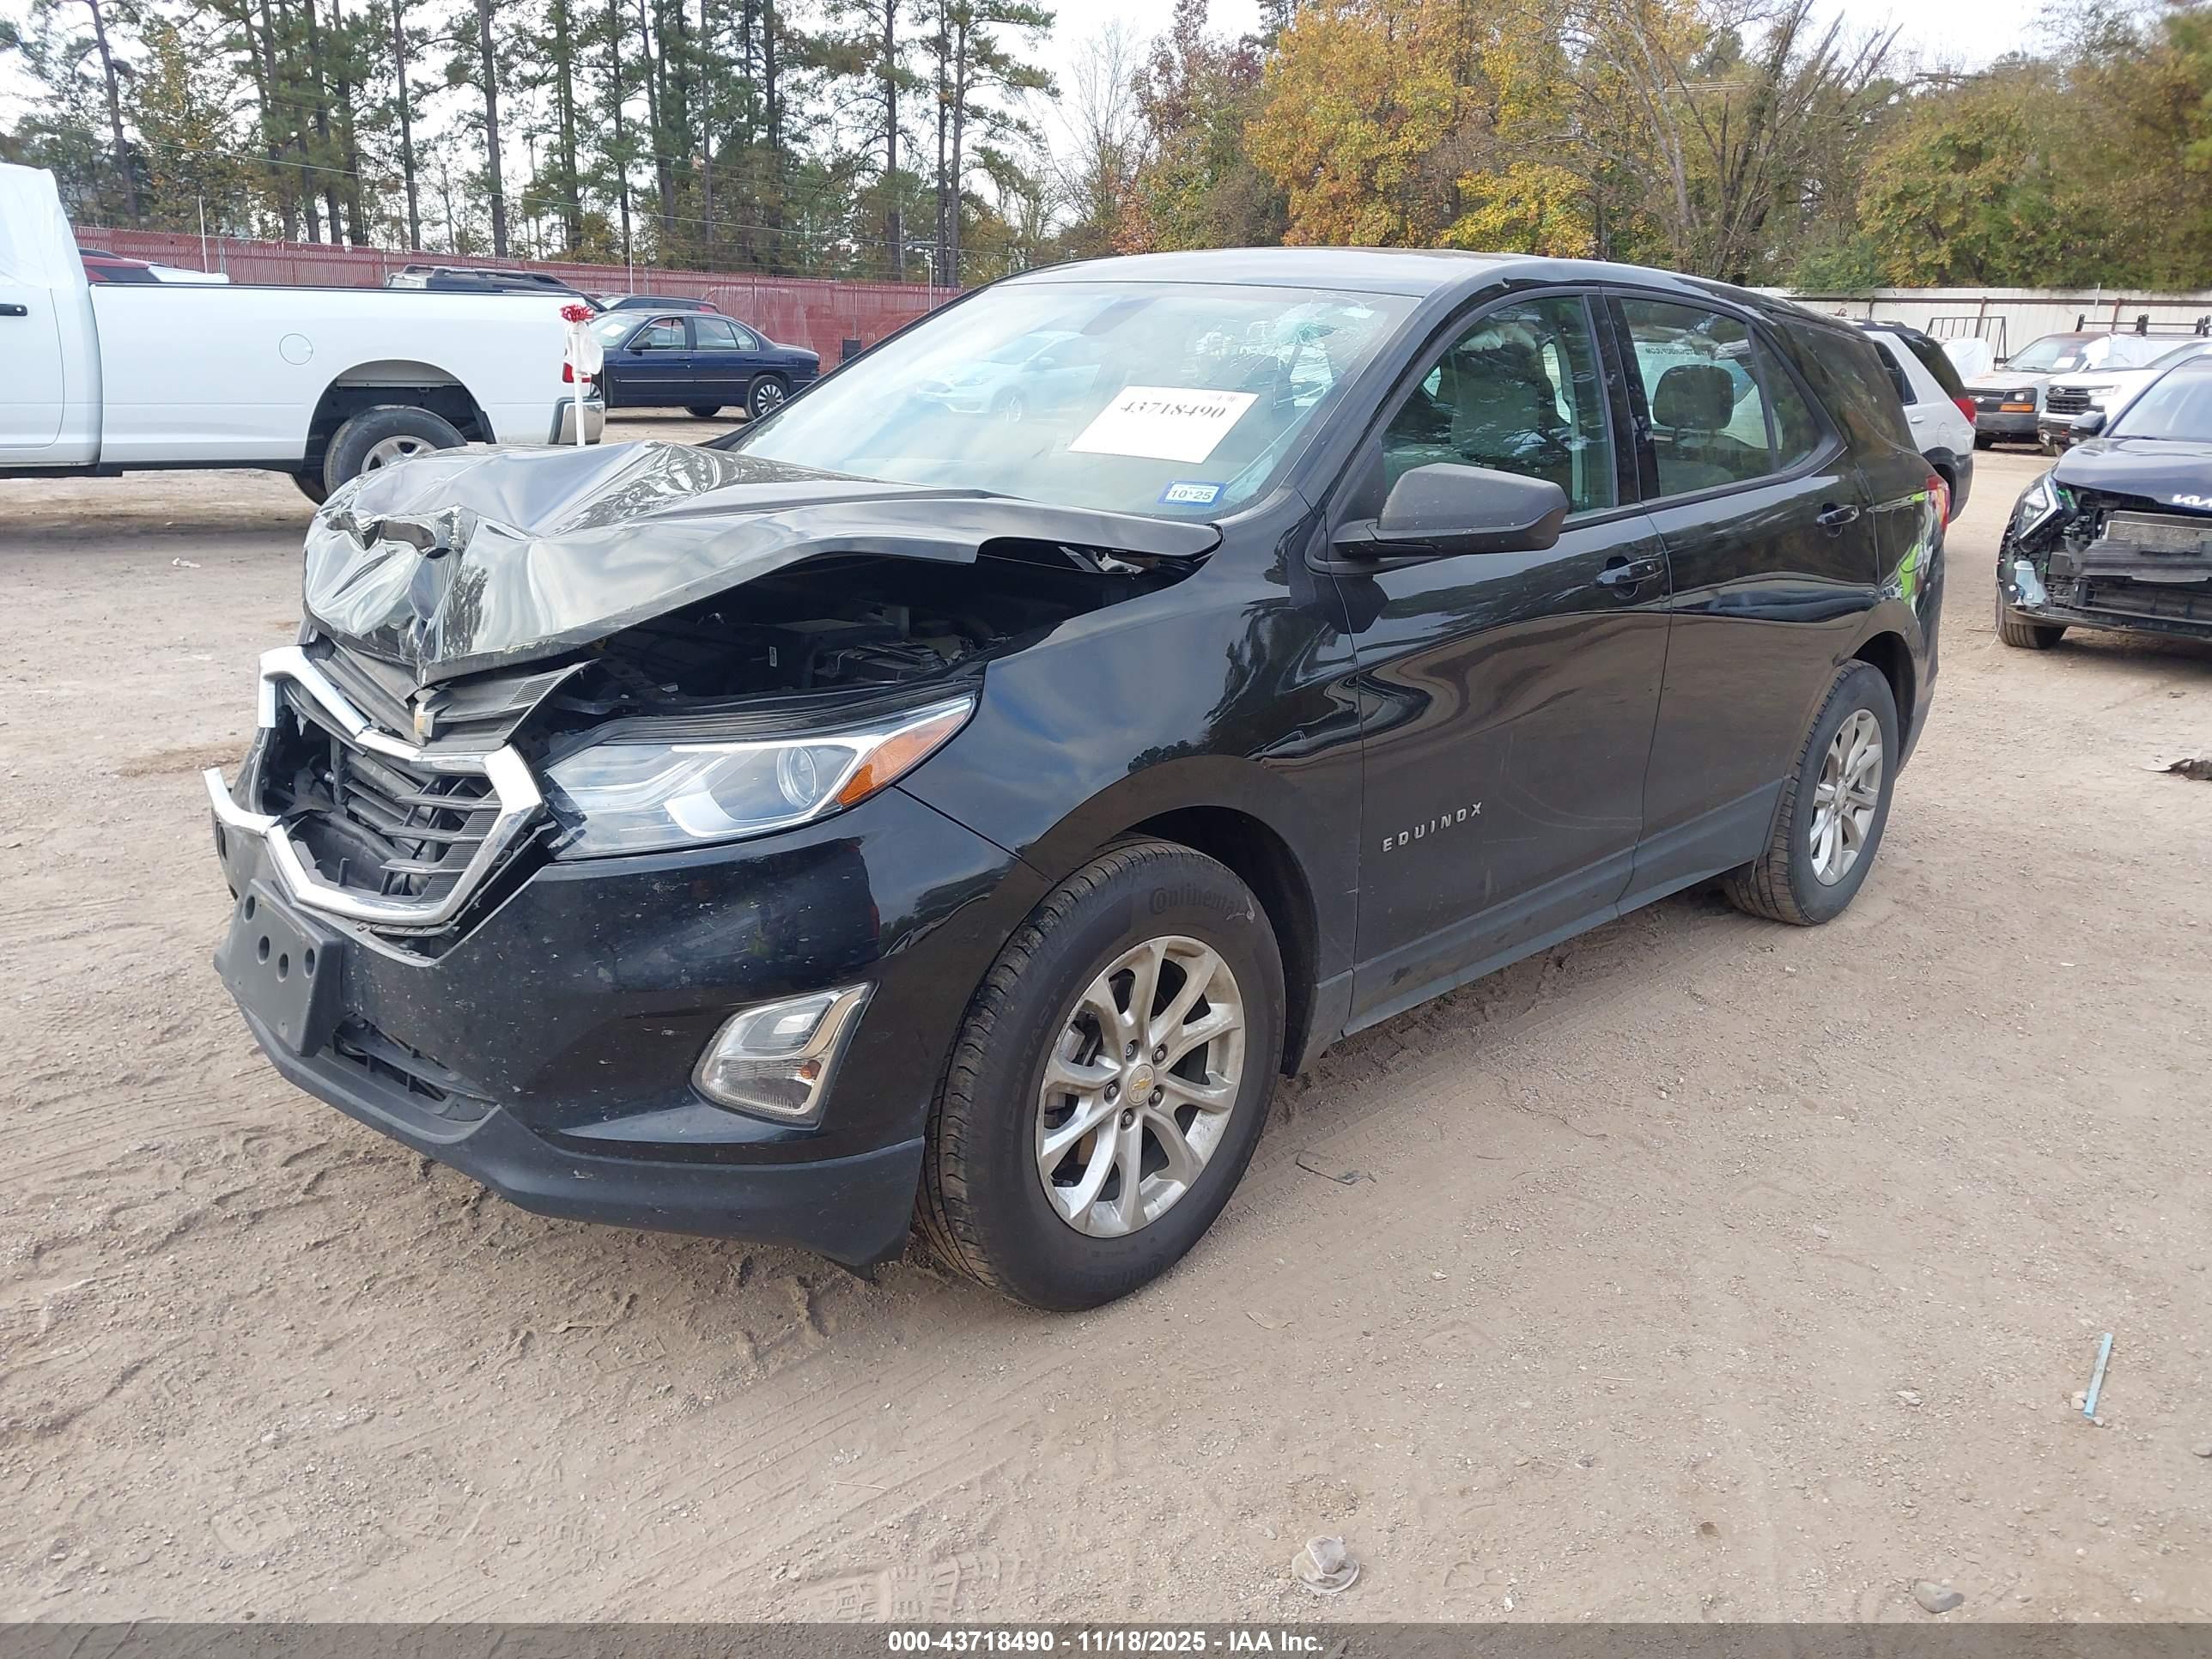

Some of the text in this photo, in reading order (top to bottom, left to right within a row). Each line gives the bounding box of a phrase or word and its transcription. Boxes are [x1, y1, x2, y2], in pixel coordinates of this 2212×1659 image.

[1121, 401, 1226, 418] 43718490
[1171, 489, 1213, 500] 10 25
[1382, 801, 1482, 853] EQUINOX
